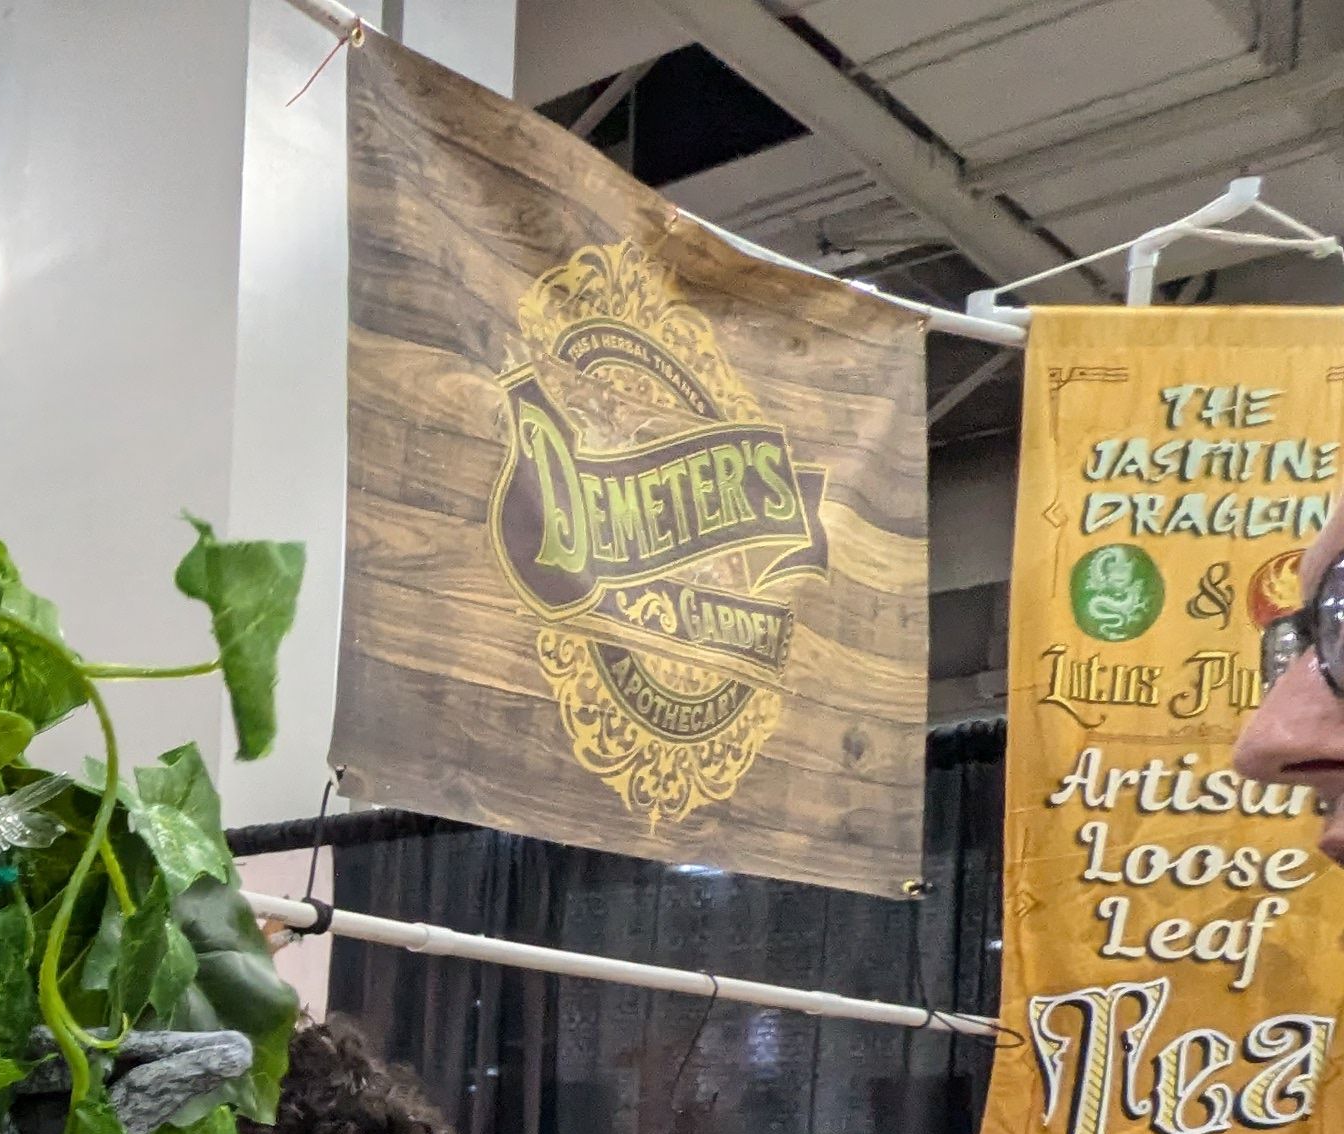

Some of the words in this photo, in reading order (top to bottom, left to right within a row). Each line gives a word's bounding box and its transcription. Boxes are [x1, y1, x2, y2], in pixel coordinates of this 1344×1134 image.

[1162, 383, 1287, 429] THE
[519, 401, 797, 574] DEMETER'S
[1084, 437, 1341, 483] JASMINE
[679, 587, 782, 659] GARDEN
[1080, 820, 1317, 890] Loose
[1097, 896, 1291, 990] Leaf
